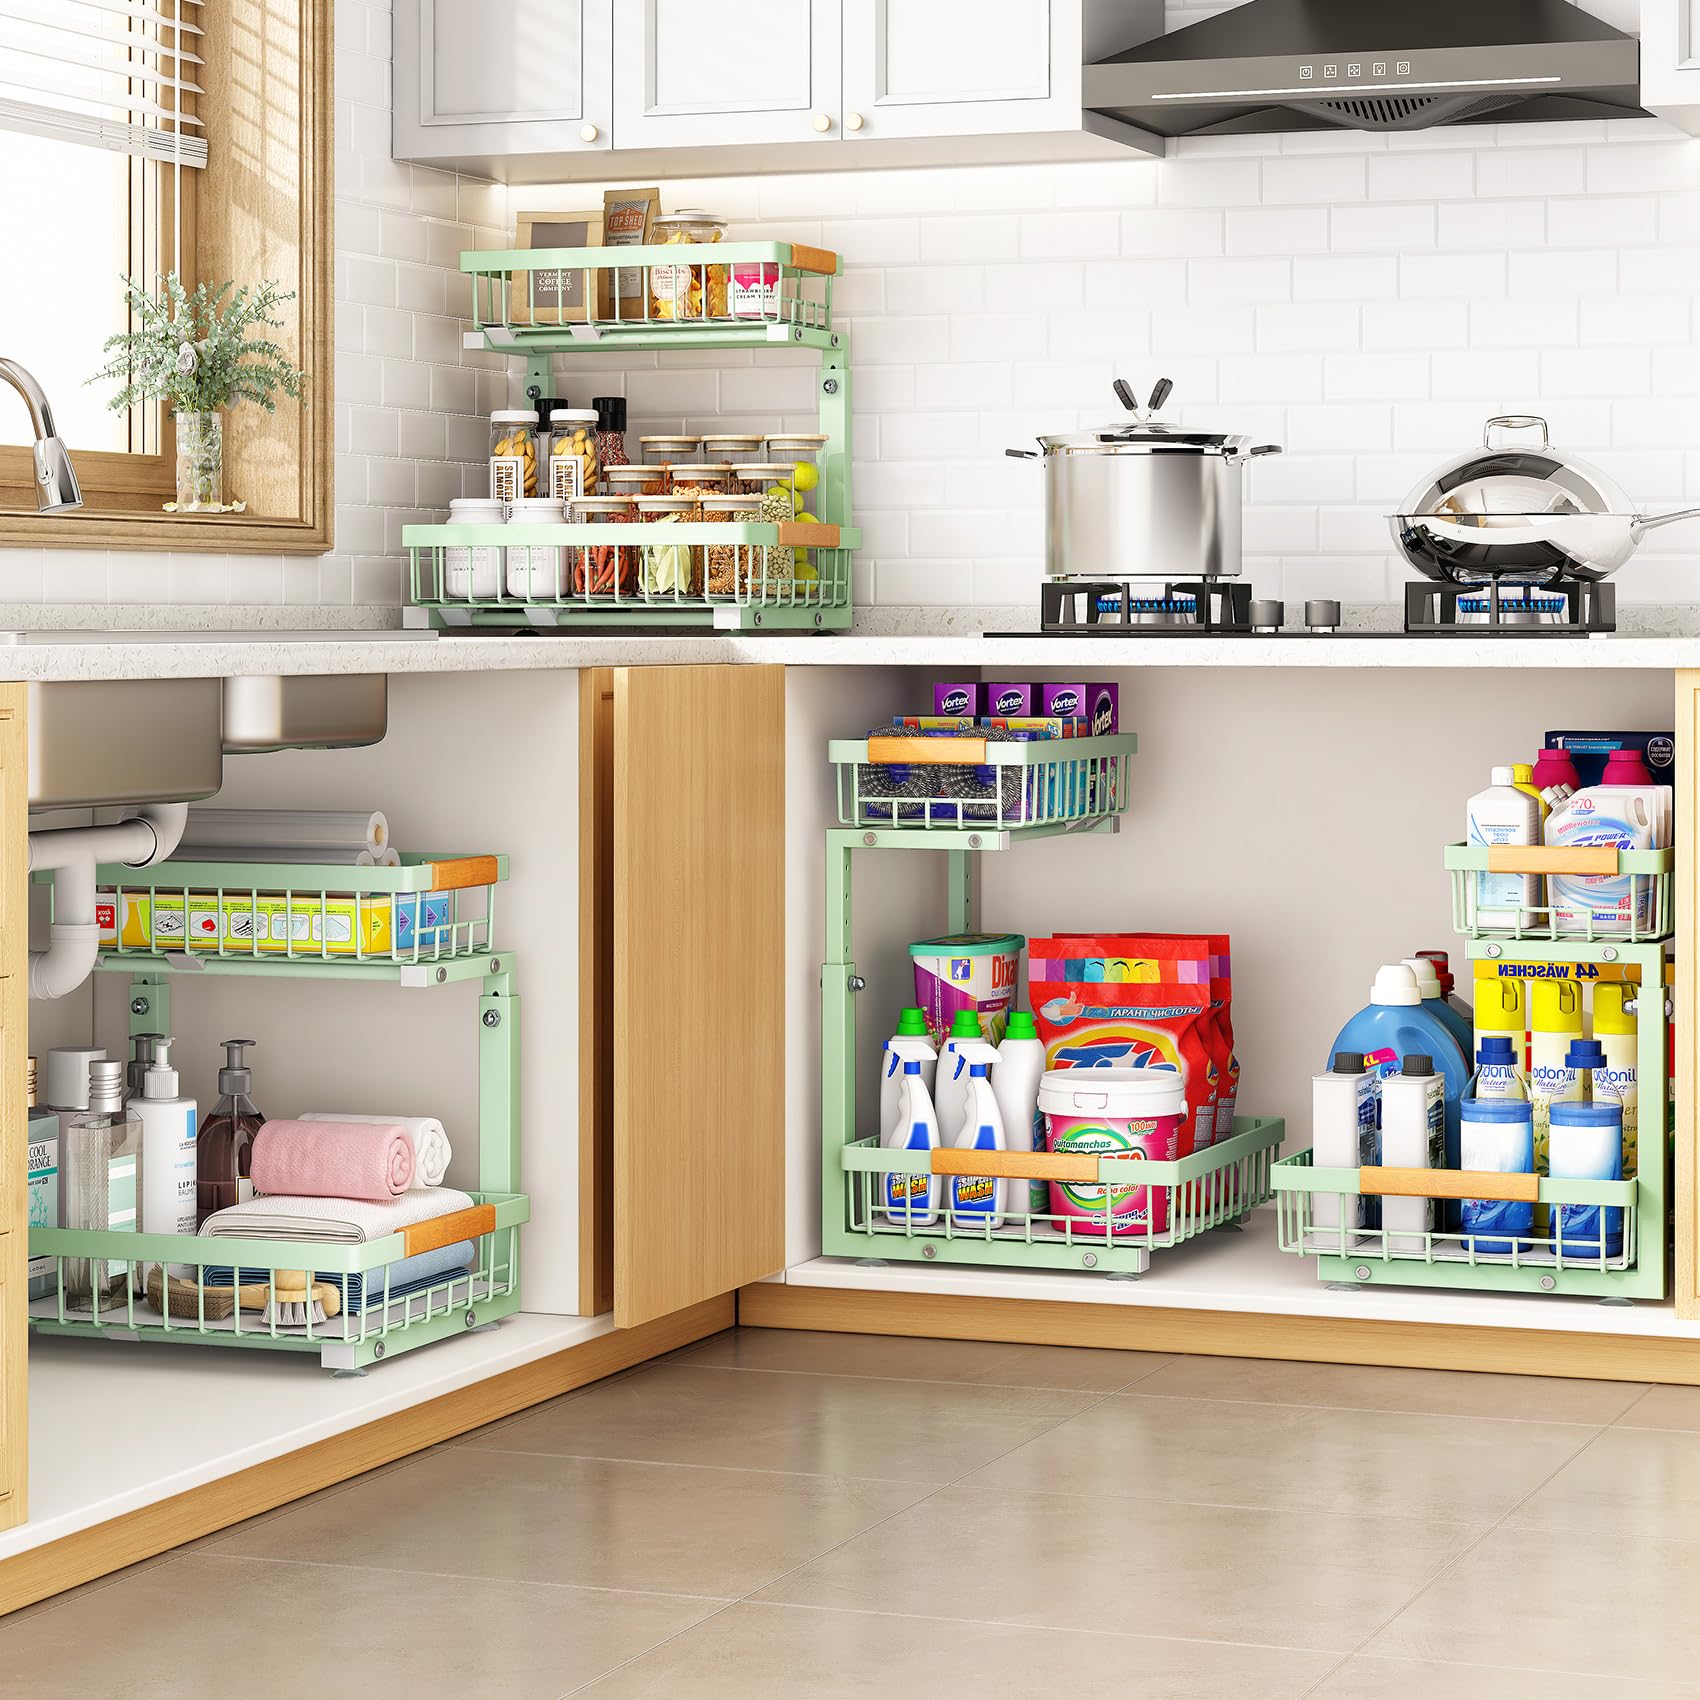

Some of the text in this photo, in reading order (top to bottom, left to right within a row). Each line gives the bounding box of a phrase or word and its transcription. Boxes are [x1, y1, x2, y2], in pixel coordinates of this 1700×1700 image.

[610, 216, 624, 227] TOP
[505, 465, 514, 502] SMOKED
[941, 695, 970, 710] Vortex
[996, 695, 1024, 710] Vortex
[1050, 695, 1079, 710] Vortex
[1091, 703, 1113, 736] Vortex
[1578, 798, 1592, 809] 70
[1595, 832, 1626, 842] POWER
[1110, 1008, 1149, 1017] ГАРАНТ
[1151, 1006, 1198, 1017] ЧИСТОТЫ
[1480, 1078, 1508, 1087] Nature
[1130, 1121, 1145, 1132] 100
[1053, 1140, 1112, 1149] Quitamanchas
[29, 1145, 47, 1158] COOL
[958, 1181, 993, 1200] WASH
[1097, 1185, 1140, 1195] Roa color
